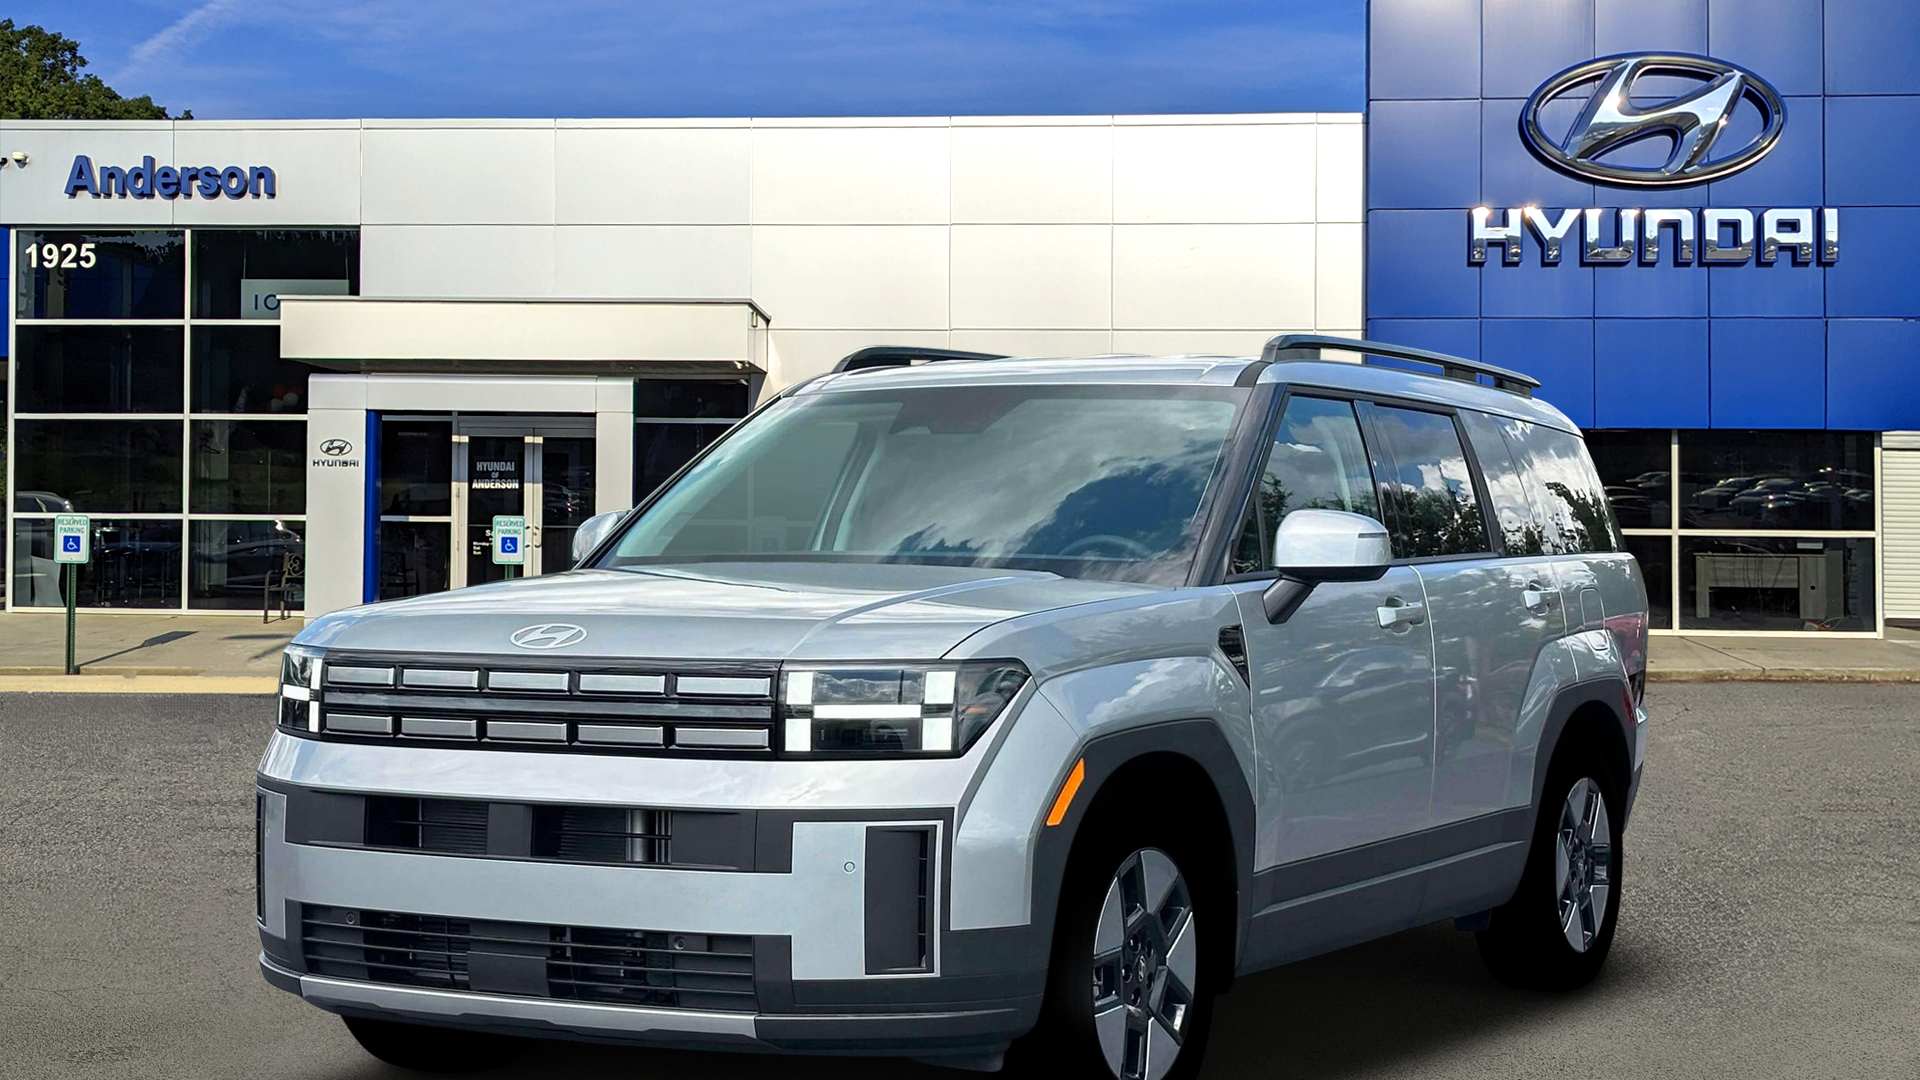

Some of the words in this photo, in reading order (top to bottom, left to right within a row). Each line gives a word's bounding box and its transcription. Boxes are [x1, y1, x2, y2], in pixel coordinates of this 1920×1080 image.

[64, 155, 277, 199] Anderson
[1468, 206, 1840, 267] HYUNDAI
[25, 243, 97, 269] 1925
[312, 459, 359, 467] HYUNDAI
[476, 461, 515, 472] HYUNDAI
[472, 479, 519, 489] ANDERSON
[57, 518, 88, 526] RESERVED
[495, 520, 524, 528] RESERVED
[497, 528, 521, 536] PARKING
